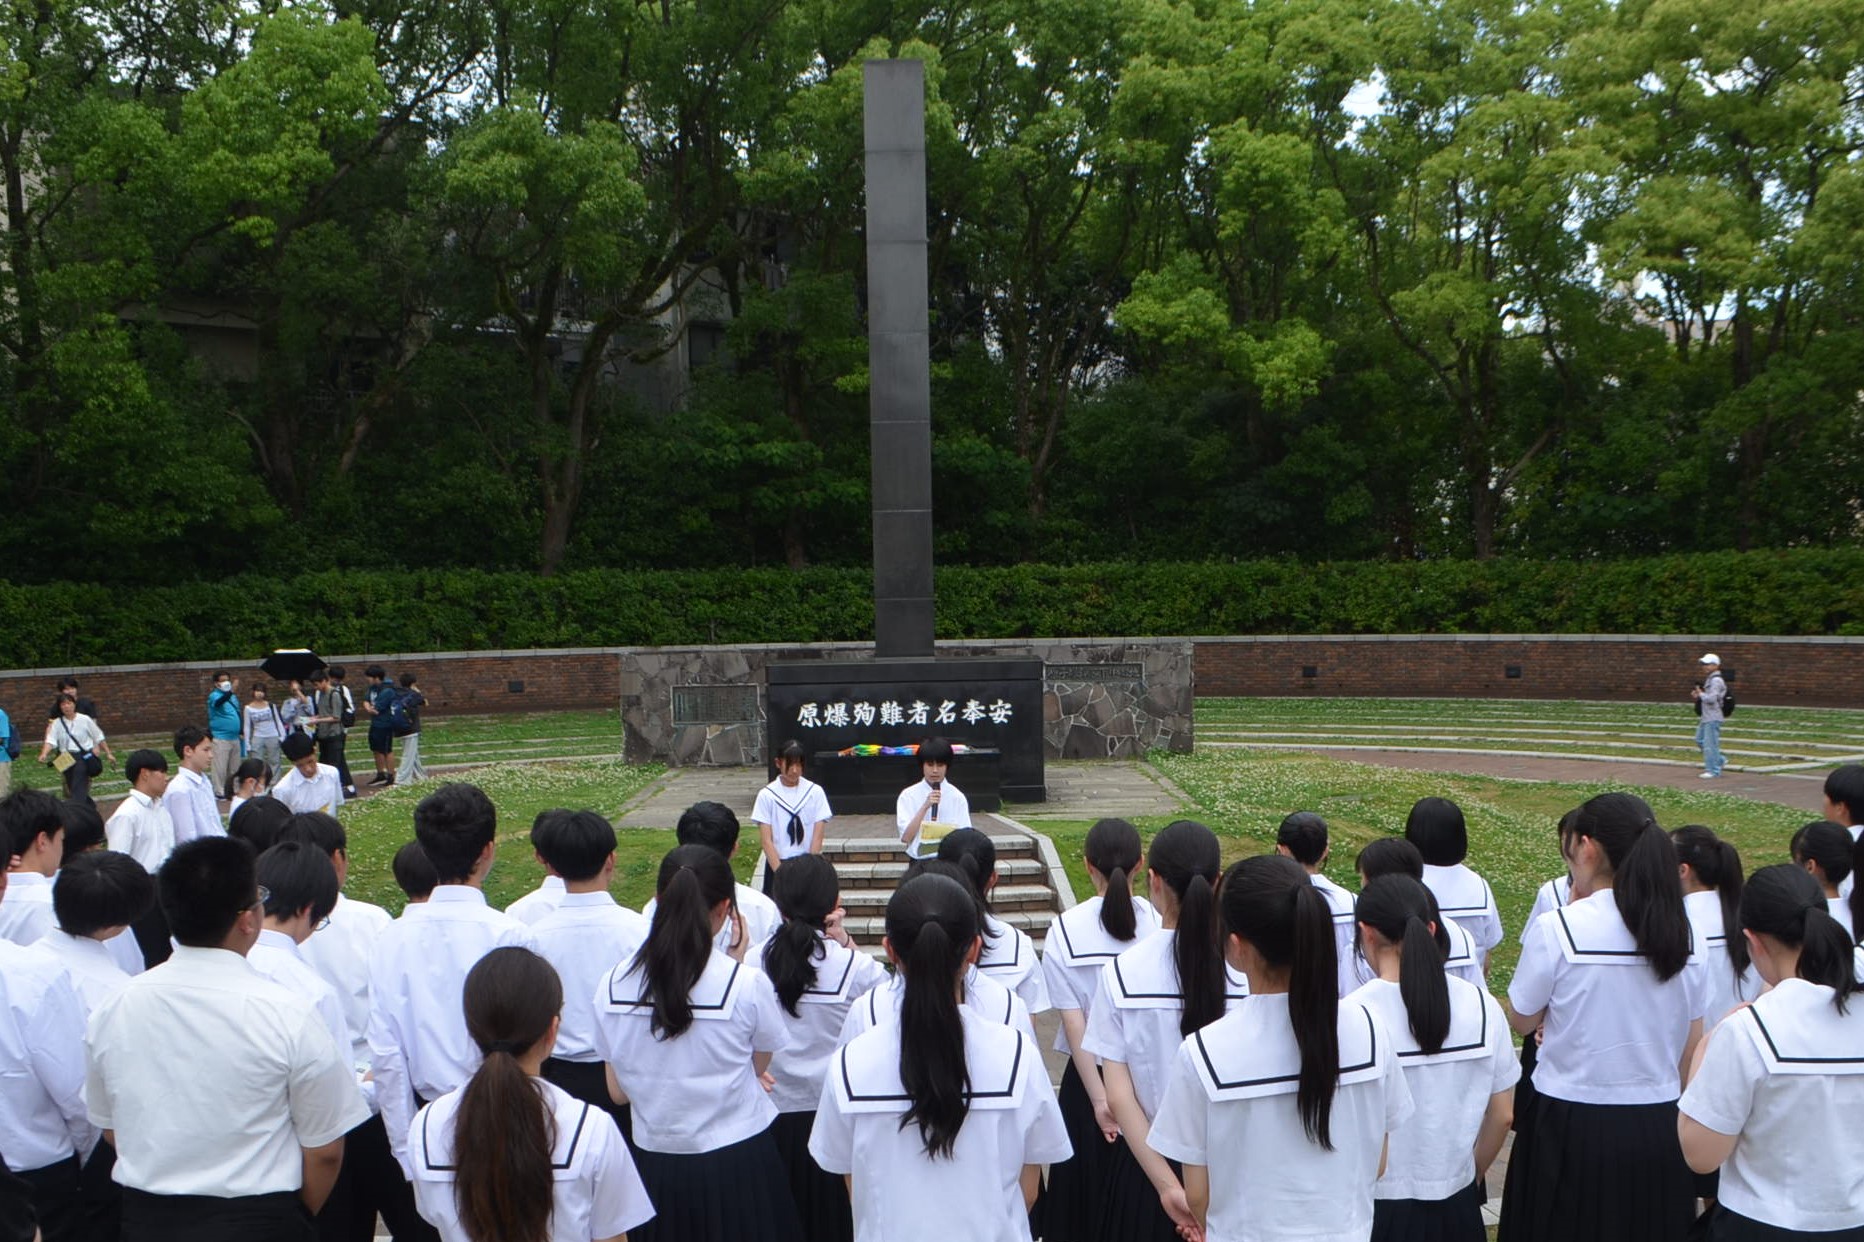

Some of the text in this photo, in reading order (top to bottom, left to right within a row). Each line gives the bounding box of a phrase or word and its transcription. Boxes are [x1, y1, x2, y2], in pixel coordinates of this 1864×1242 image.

[797, 699, 1013, 728] 原爆殉難者名奉安
